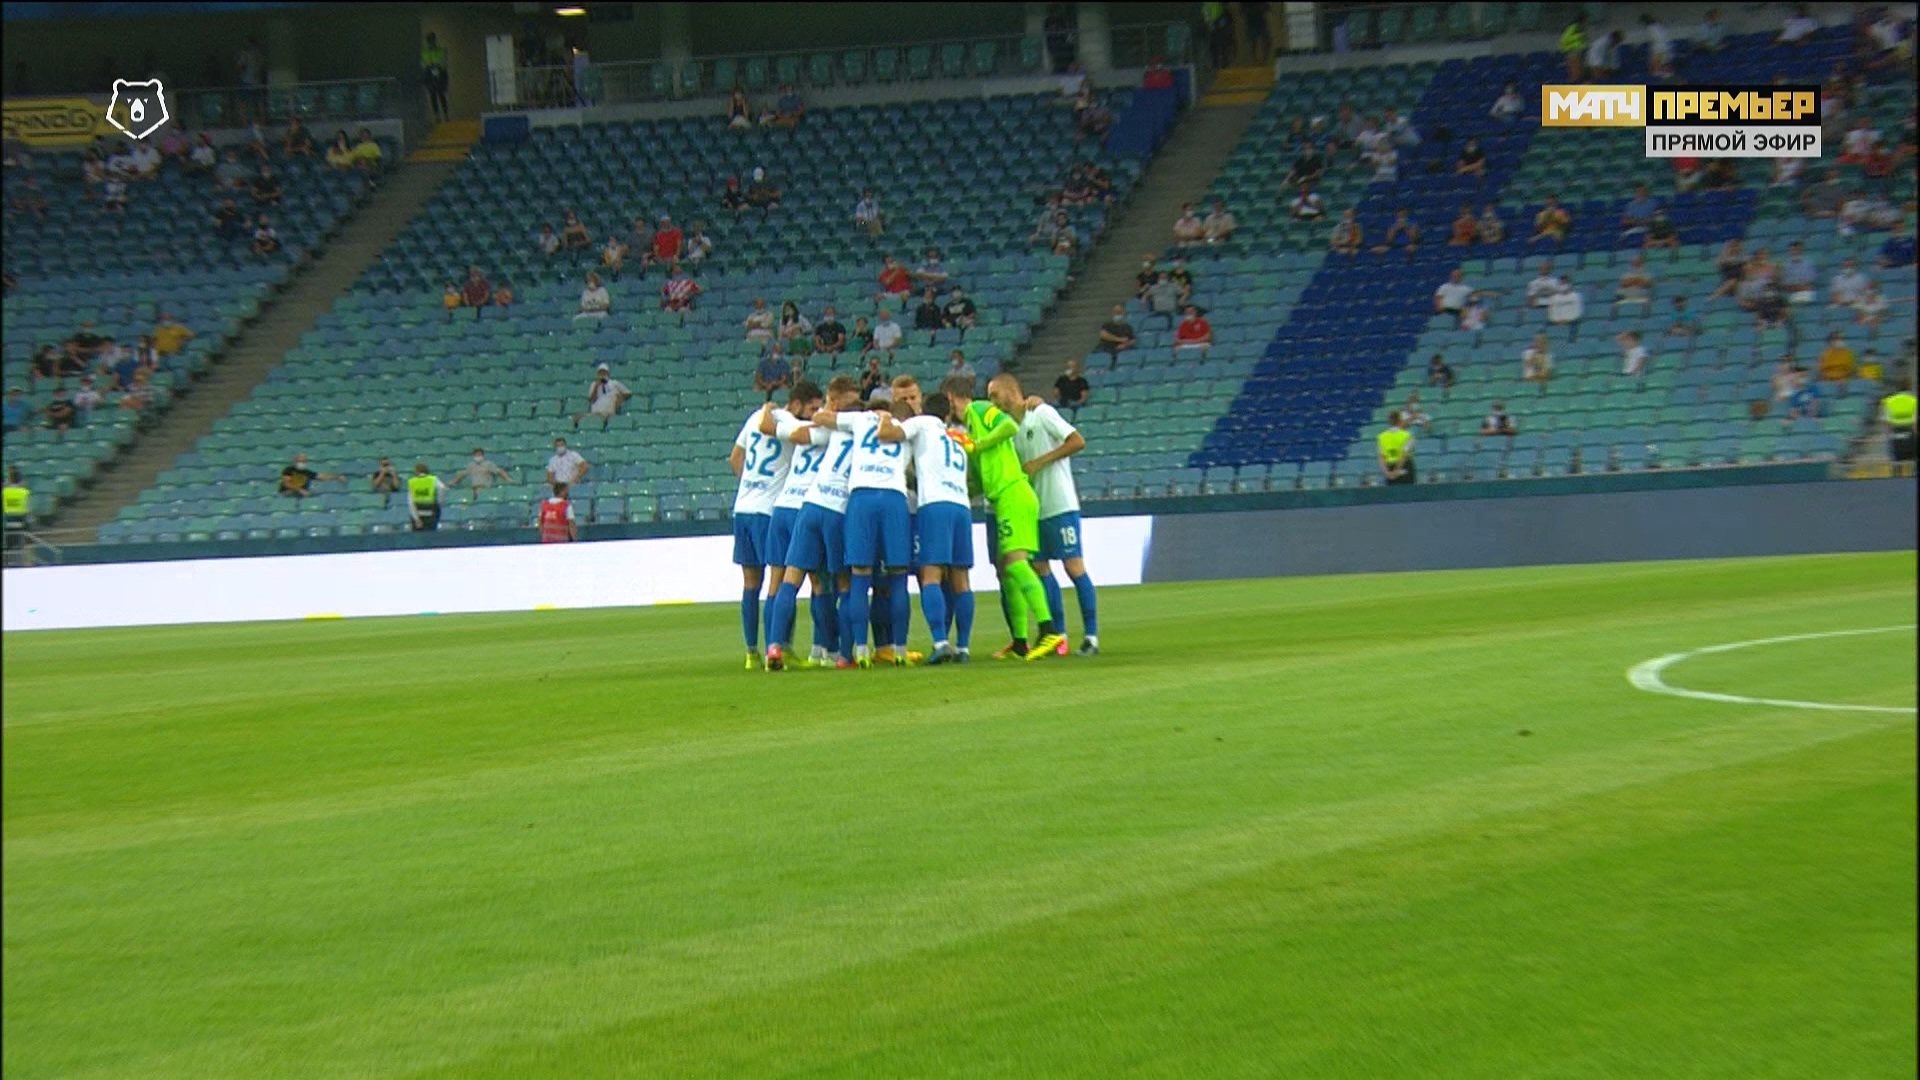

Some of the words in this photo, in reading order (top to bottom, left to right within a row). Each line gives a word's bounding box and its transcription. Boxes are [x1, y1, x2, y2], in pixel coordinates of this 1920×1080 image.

[745, 431, 782, 477] 32
[940, 435, 965, 472] 15
[1060, 526, 1077, 546] 18
